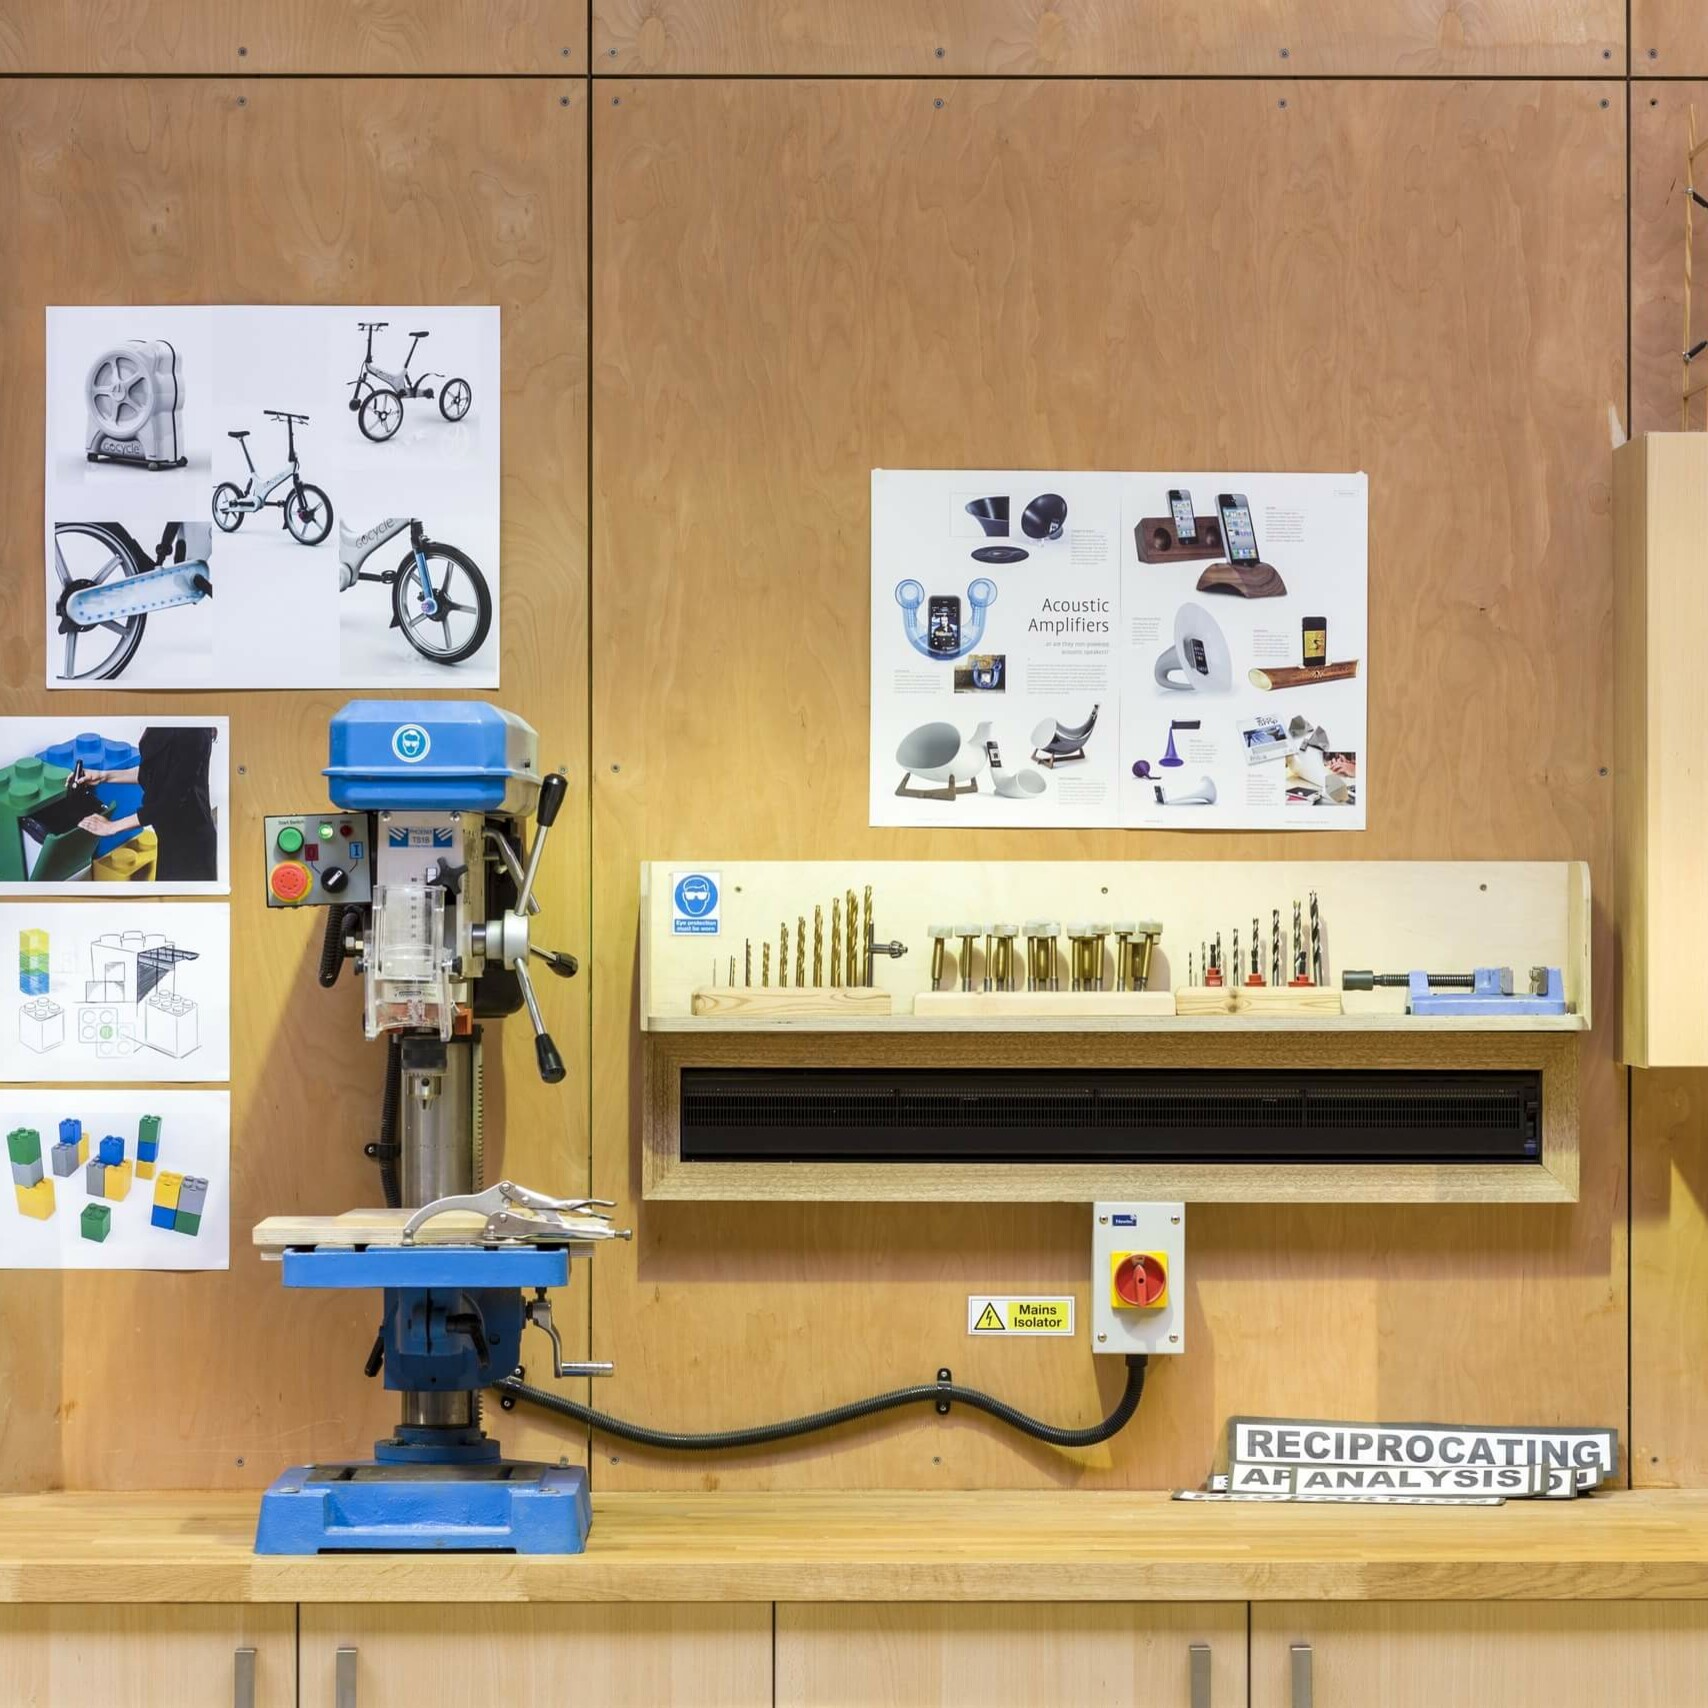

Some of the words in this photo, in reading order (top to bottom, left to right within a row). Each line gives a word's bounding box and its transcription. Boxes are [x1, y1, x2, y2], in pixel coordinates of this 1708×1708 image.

[1042, 598, 1109, 612] Acoustic
[1028, 617, 1109, 636] Amplifiers
[1019, 1304, 1057, 1315] Mains
[1014, 1317, 1062, 1328] Isolator
[1247, 1429, 1601, 1467] RECIPROCATING
[1303, 1469, 1522, 1488] ANALYSIS
